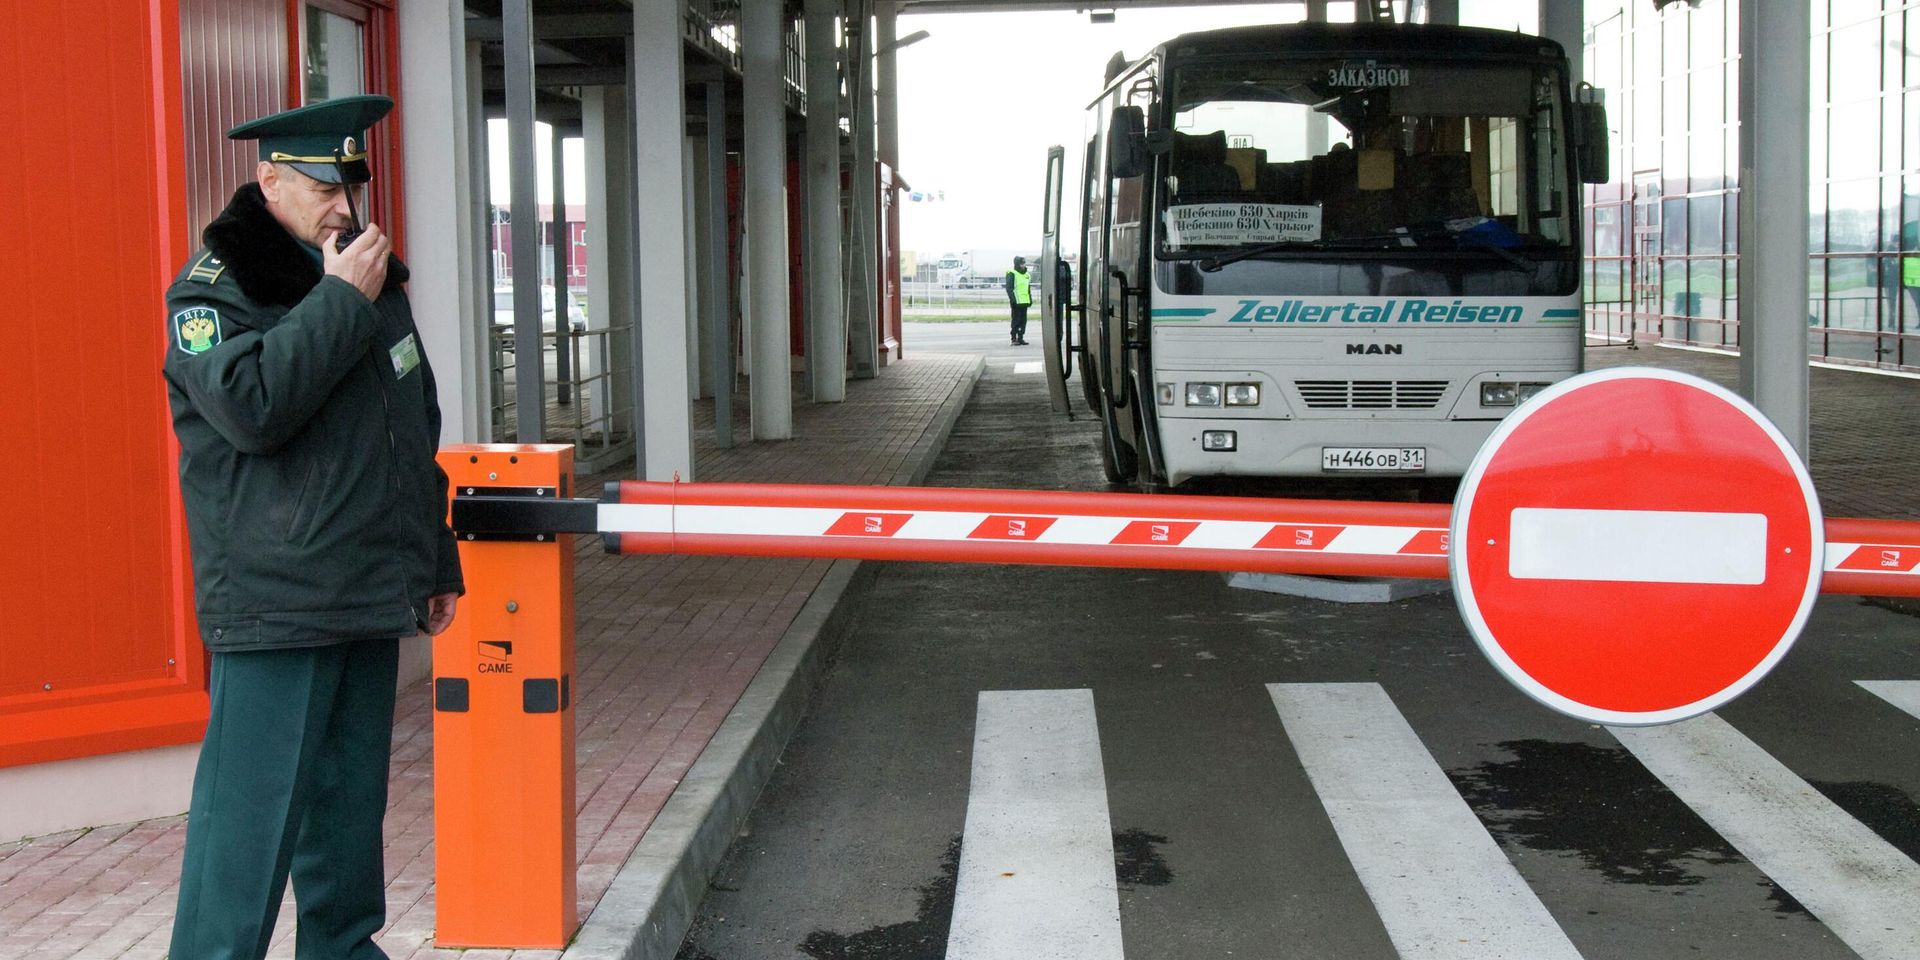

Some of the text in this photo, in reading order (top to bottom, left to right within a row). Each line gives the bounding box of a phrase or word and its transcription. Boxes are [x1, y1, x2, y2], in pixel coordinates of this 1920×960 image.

[1240, 205, 1263, 217] 630
[1267, 207, 1308, 221] Харків
[1237, 217, 1260, 229] 630
[1228, 300, 1524, 323] Zellertal Reisen
[1346, 343, 1402, 355] MAN
[1403, 450, 1419, 462] 31
[478, 662, 513, 674] CAME
